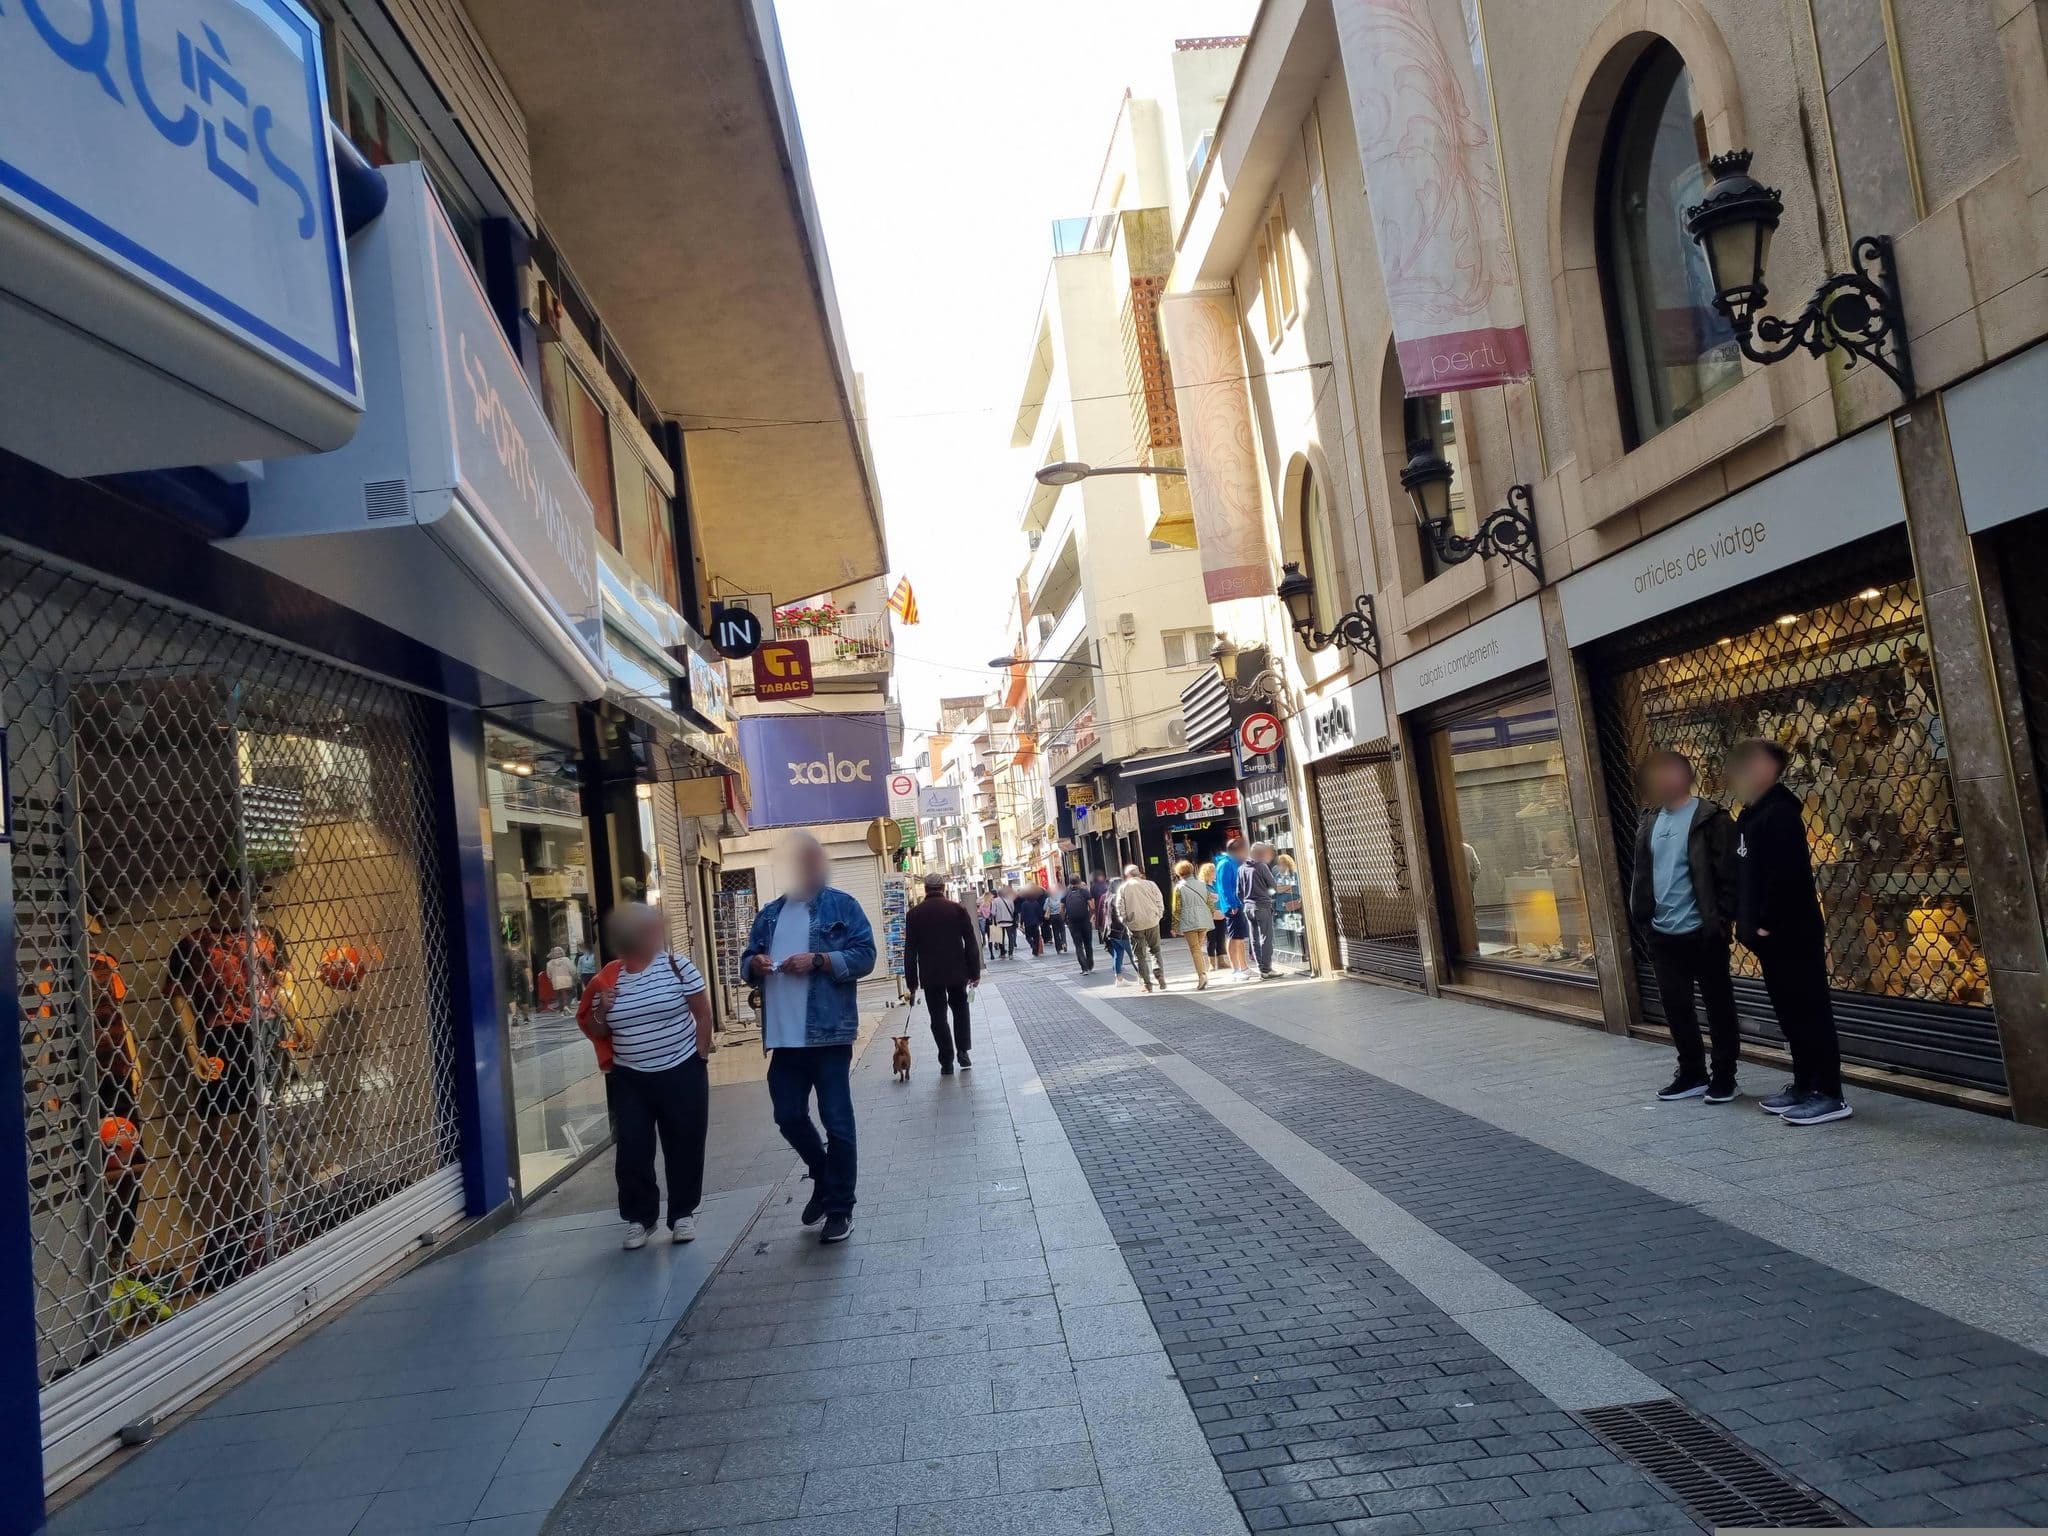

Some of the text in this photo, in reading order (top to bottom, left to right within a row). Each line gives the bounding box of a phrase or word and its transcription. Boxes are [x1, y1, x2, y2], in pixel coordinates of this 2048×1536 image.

[1634, 522, 1766, 594] articles de viatge
[720, 619, 752, 647] IN
[1447, 637, 1500, 674] complements
[760, 681, 809, 694] TABACS
[787, 751, 872, 786] xaloc
[1155, 797, 1190, 818] PRO
